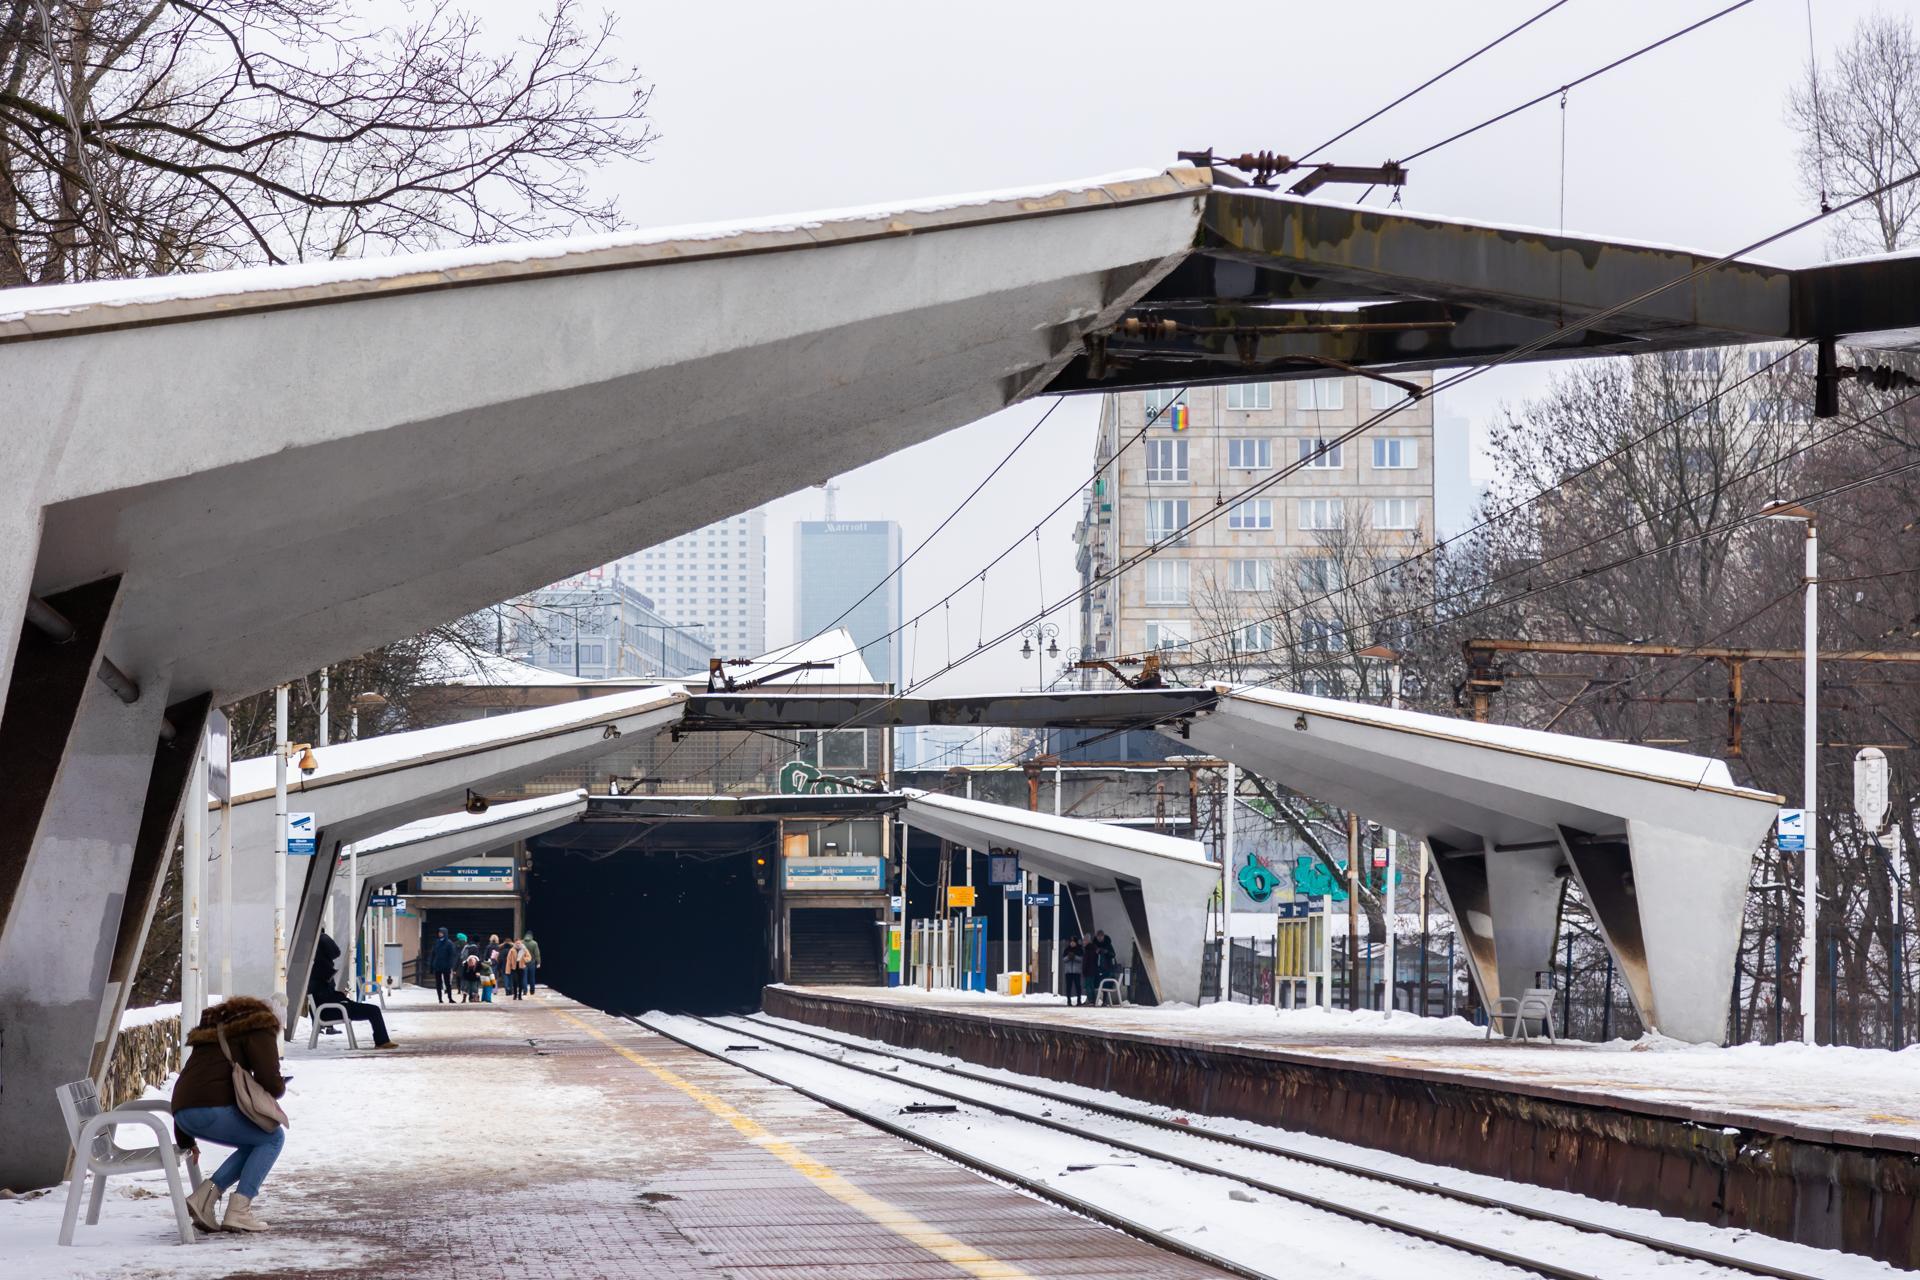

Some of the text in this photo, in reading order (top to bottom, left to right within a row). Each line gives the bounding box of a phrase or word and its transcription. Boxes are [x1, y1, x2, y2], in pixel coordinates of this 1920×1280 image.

[824, 523, 868, 533] Marriott
[390, 898, 395, 906] 1
[1027, 896, 1034, 905] 2
